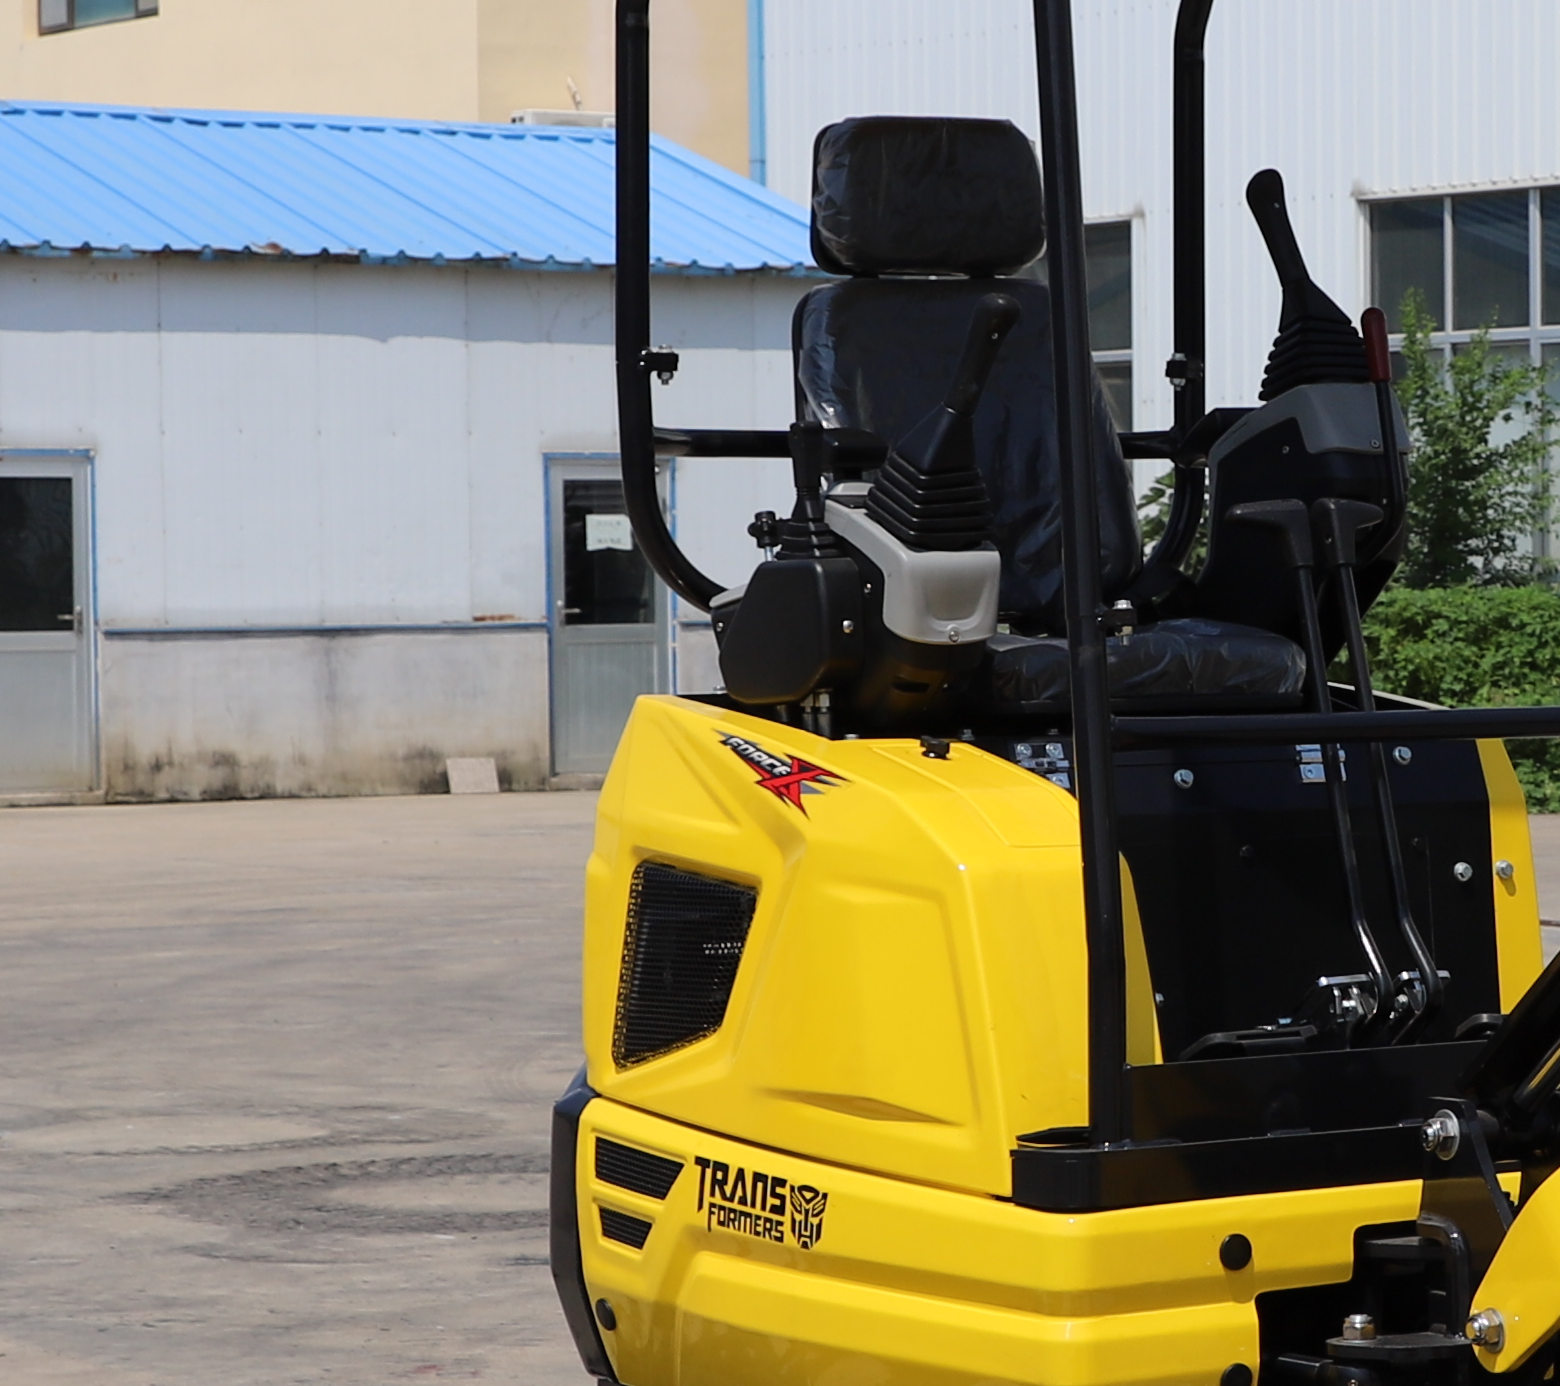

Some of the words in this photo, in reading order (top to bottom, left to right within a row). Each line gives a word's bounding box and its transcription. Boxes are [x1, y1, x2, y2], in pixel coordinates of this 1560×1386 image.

[725, 736, 792, 776] FORCE
[694, 1155, 788, 1217] TRANS
[707, 1202, 786, 1244] FORMERS
